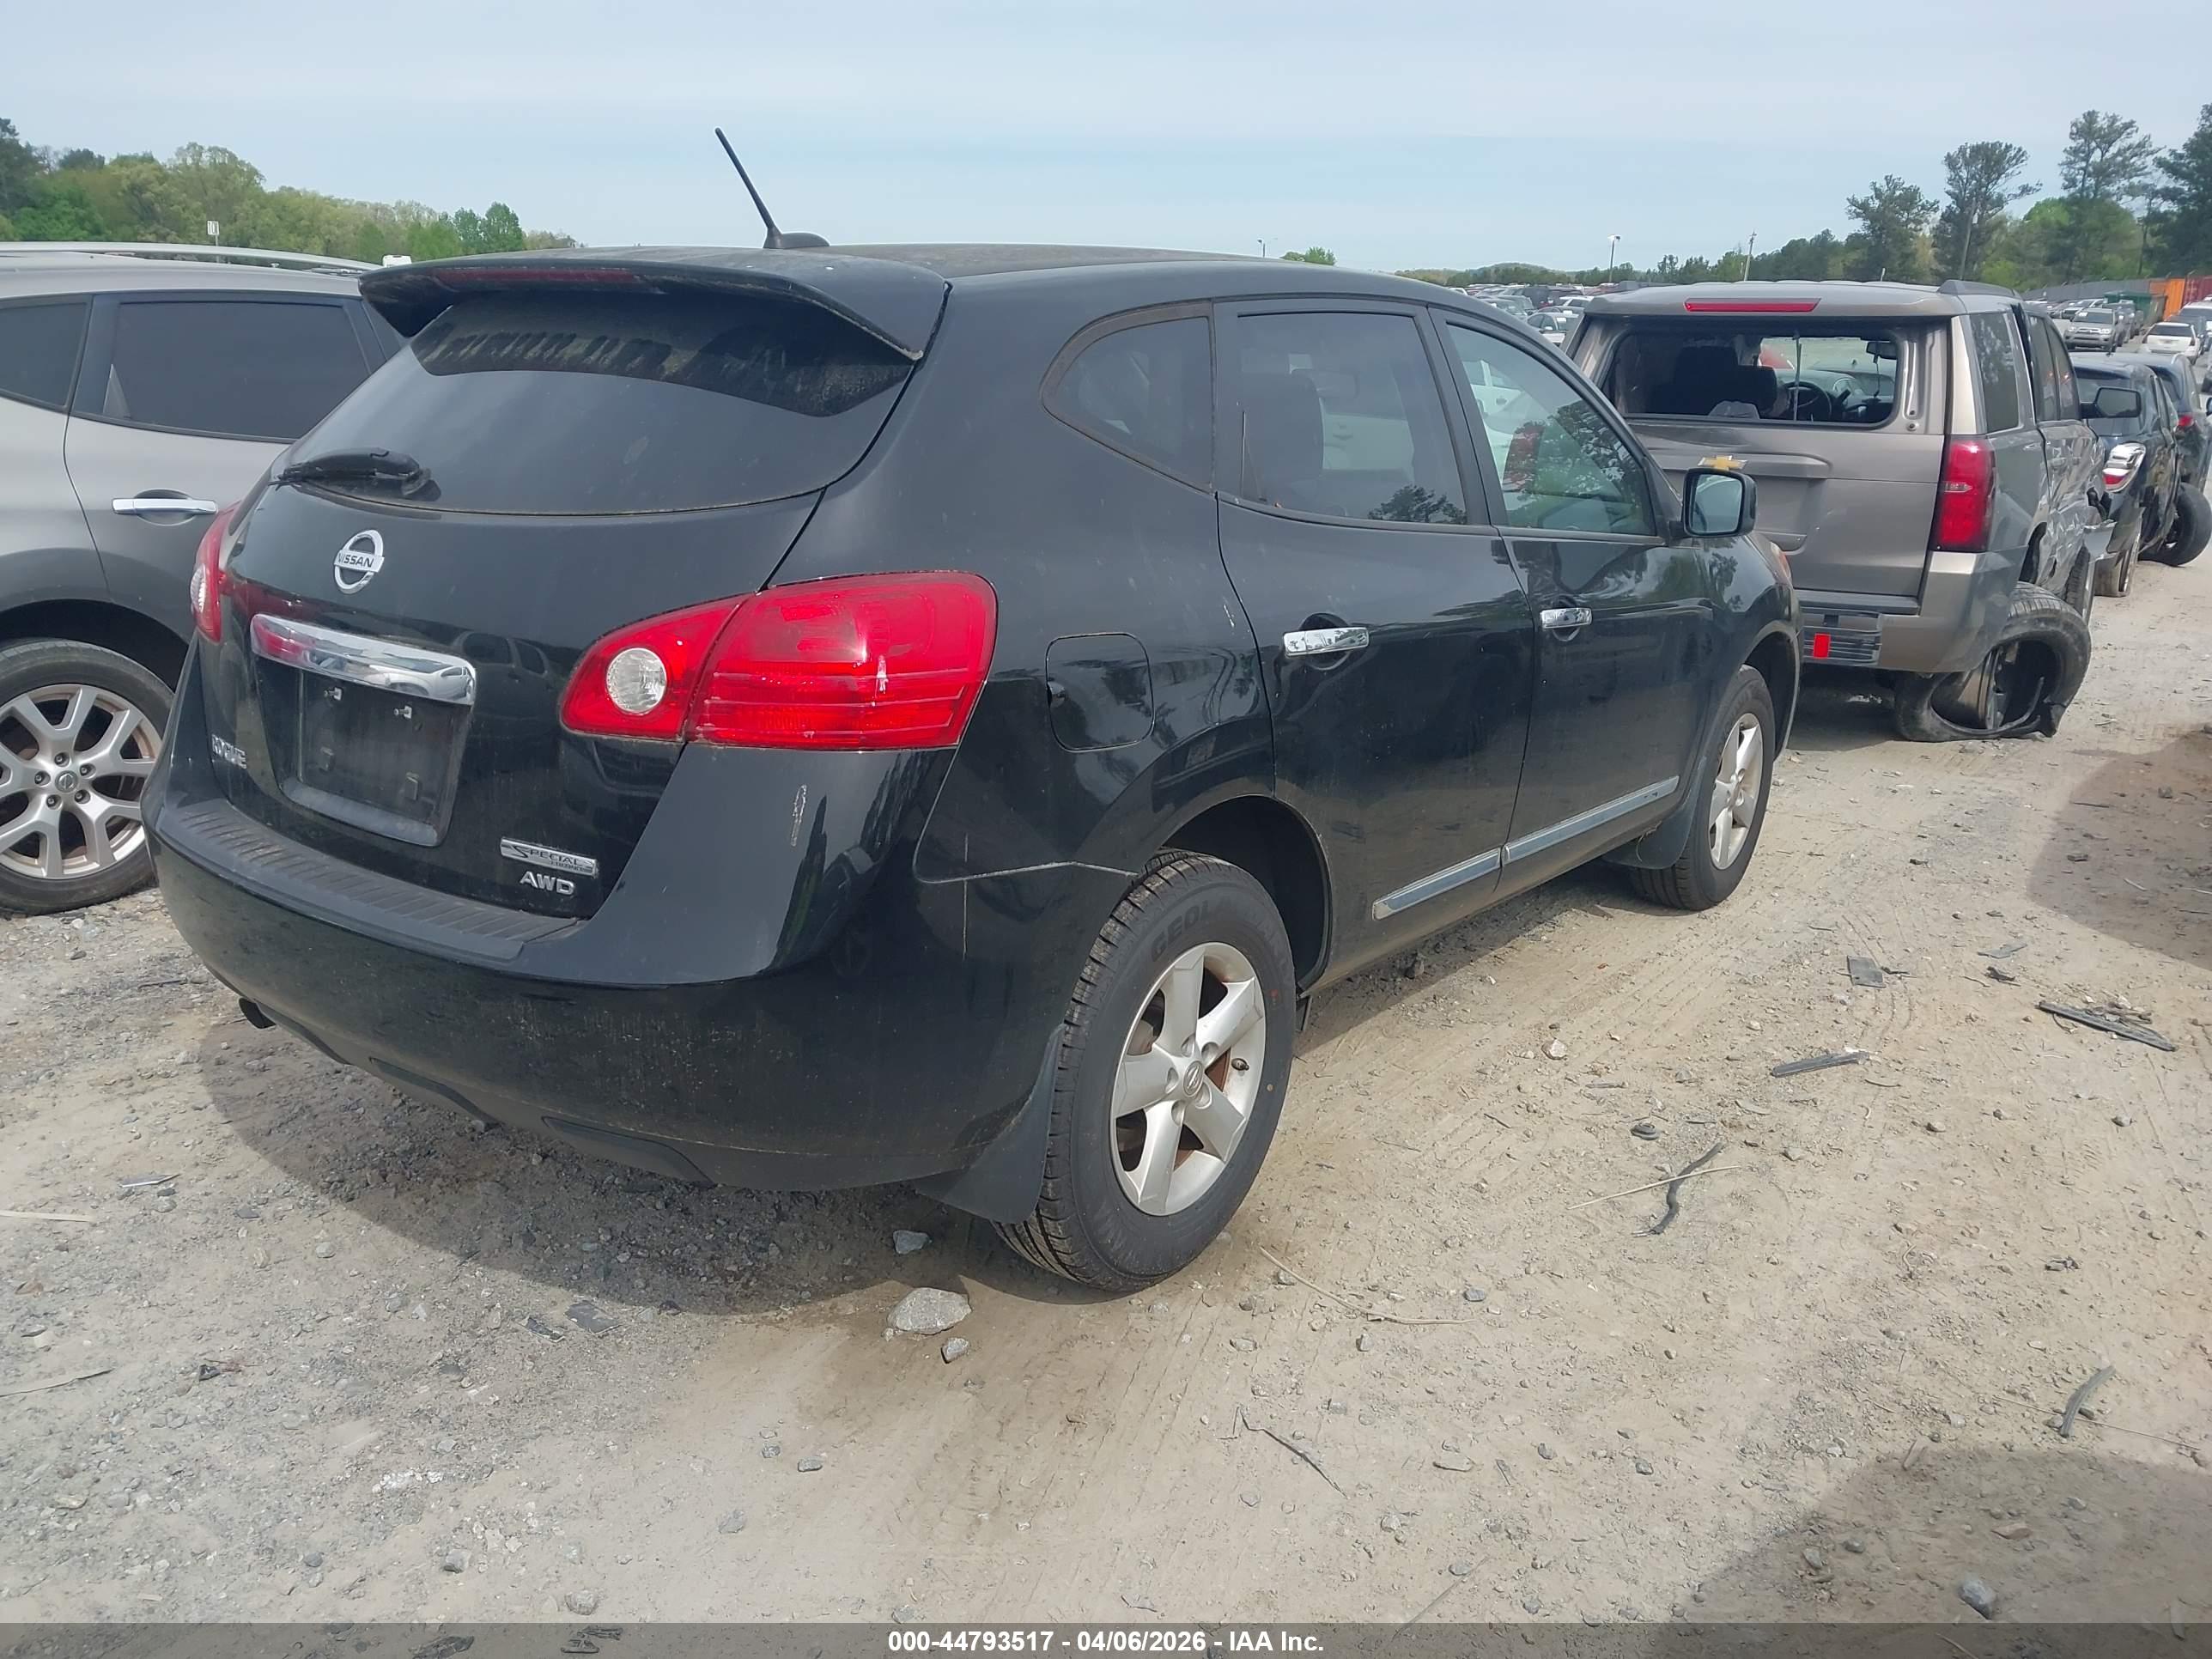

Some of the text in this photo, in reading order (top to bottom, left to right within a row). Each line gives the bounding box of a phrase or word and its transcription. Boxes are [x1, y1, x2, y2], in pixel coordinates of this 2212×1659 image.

[337, 552, 374, 568] NISSAN
[510, 845, 583, 866] SPECIAL
[520, 871, 574, 895] AWD
